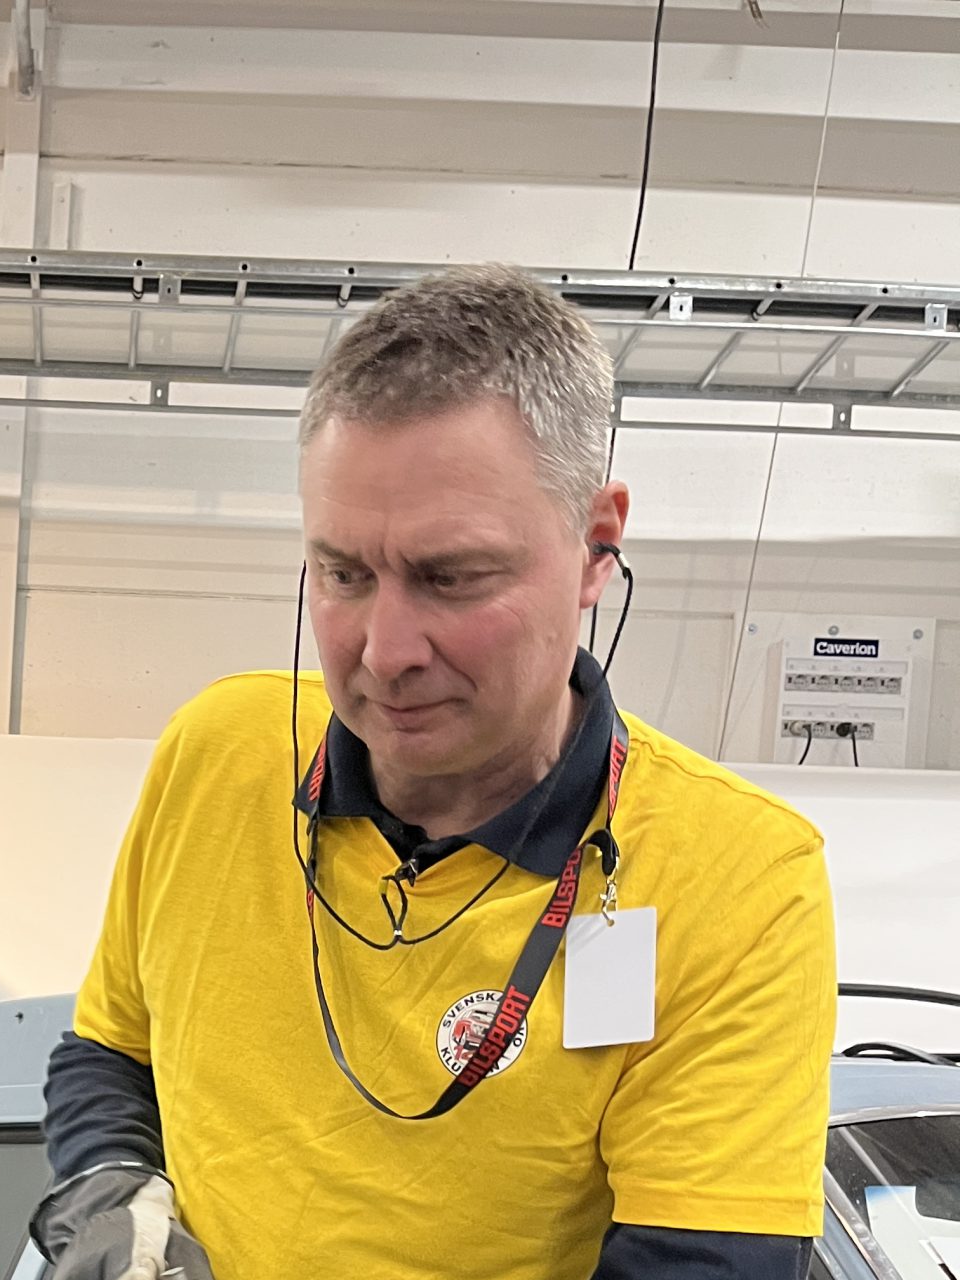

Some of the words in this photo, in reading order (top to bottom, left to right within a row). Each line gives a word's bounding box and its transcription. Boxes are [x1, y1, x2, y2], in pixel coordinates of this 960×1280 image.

[816, 641, 876, 655] Caverion
[443, 992, 501, 1028] SVENSK
[457, 985, 530, 1087] BILSPORT
